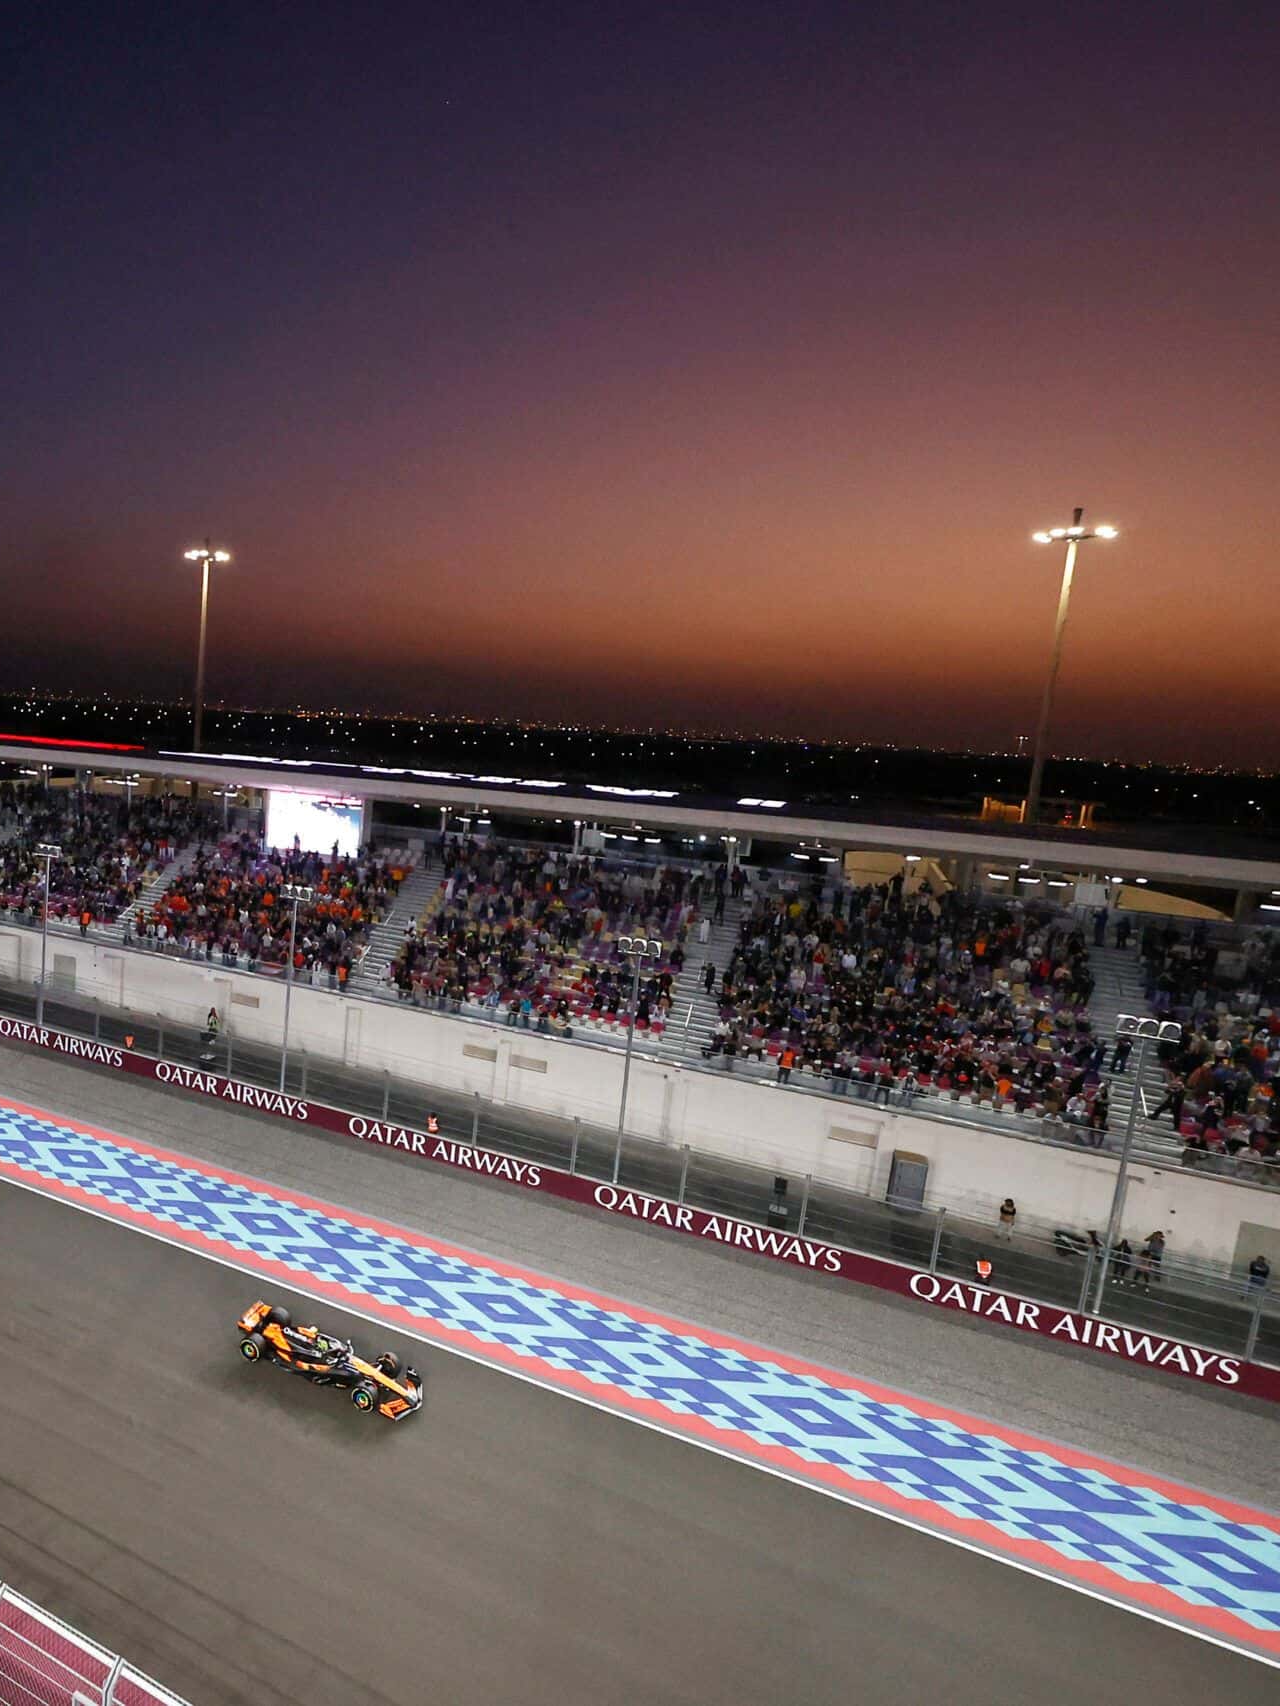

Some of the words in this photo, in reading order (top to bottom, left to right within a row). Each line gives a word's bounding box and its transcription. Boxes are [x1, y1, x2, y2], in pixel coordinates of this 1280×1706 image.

[53, 1034, 123, 1068] AIRWAYS
[155, 1063, 218, 1095] QATAR
[222, 1080, 308, 1120] AIRWAYS
[348, 1117, 427, 1154] QATAR
[432, 1140, 541, 1187] AIRWAYS
[594, 1185, 694, 1233] QATAR
[701, 1216, 843, 1273] AIRWAYS
[909, 1273, 1040, 1330] QATAR
[1051, 1313, 1240, 1385] AIRWAYS
